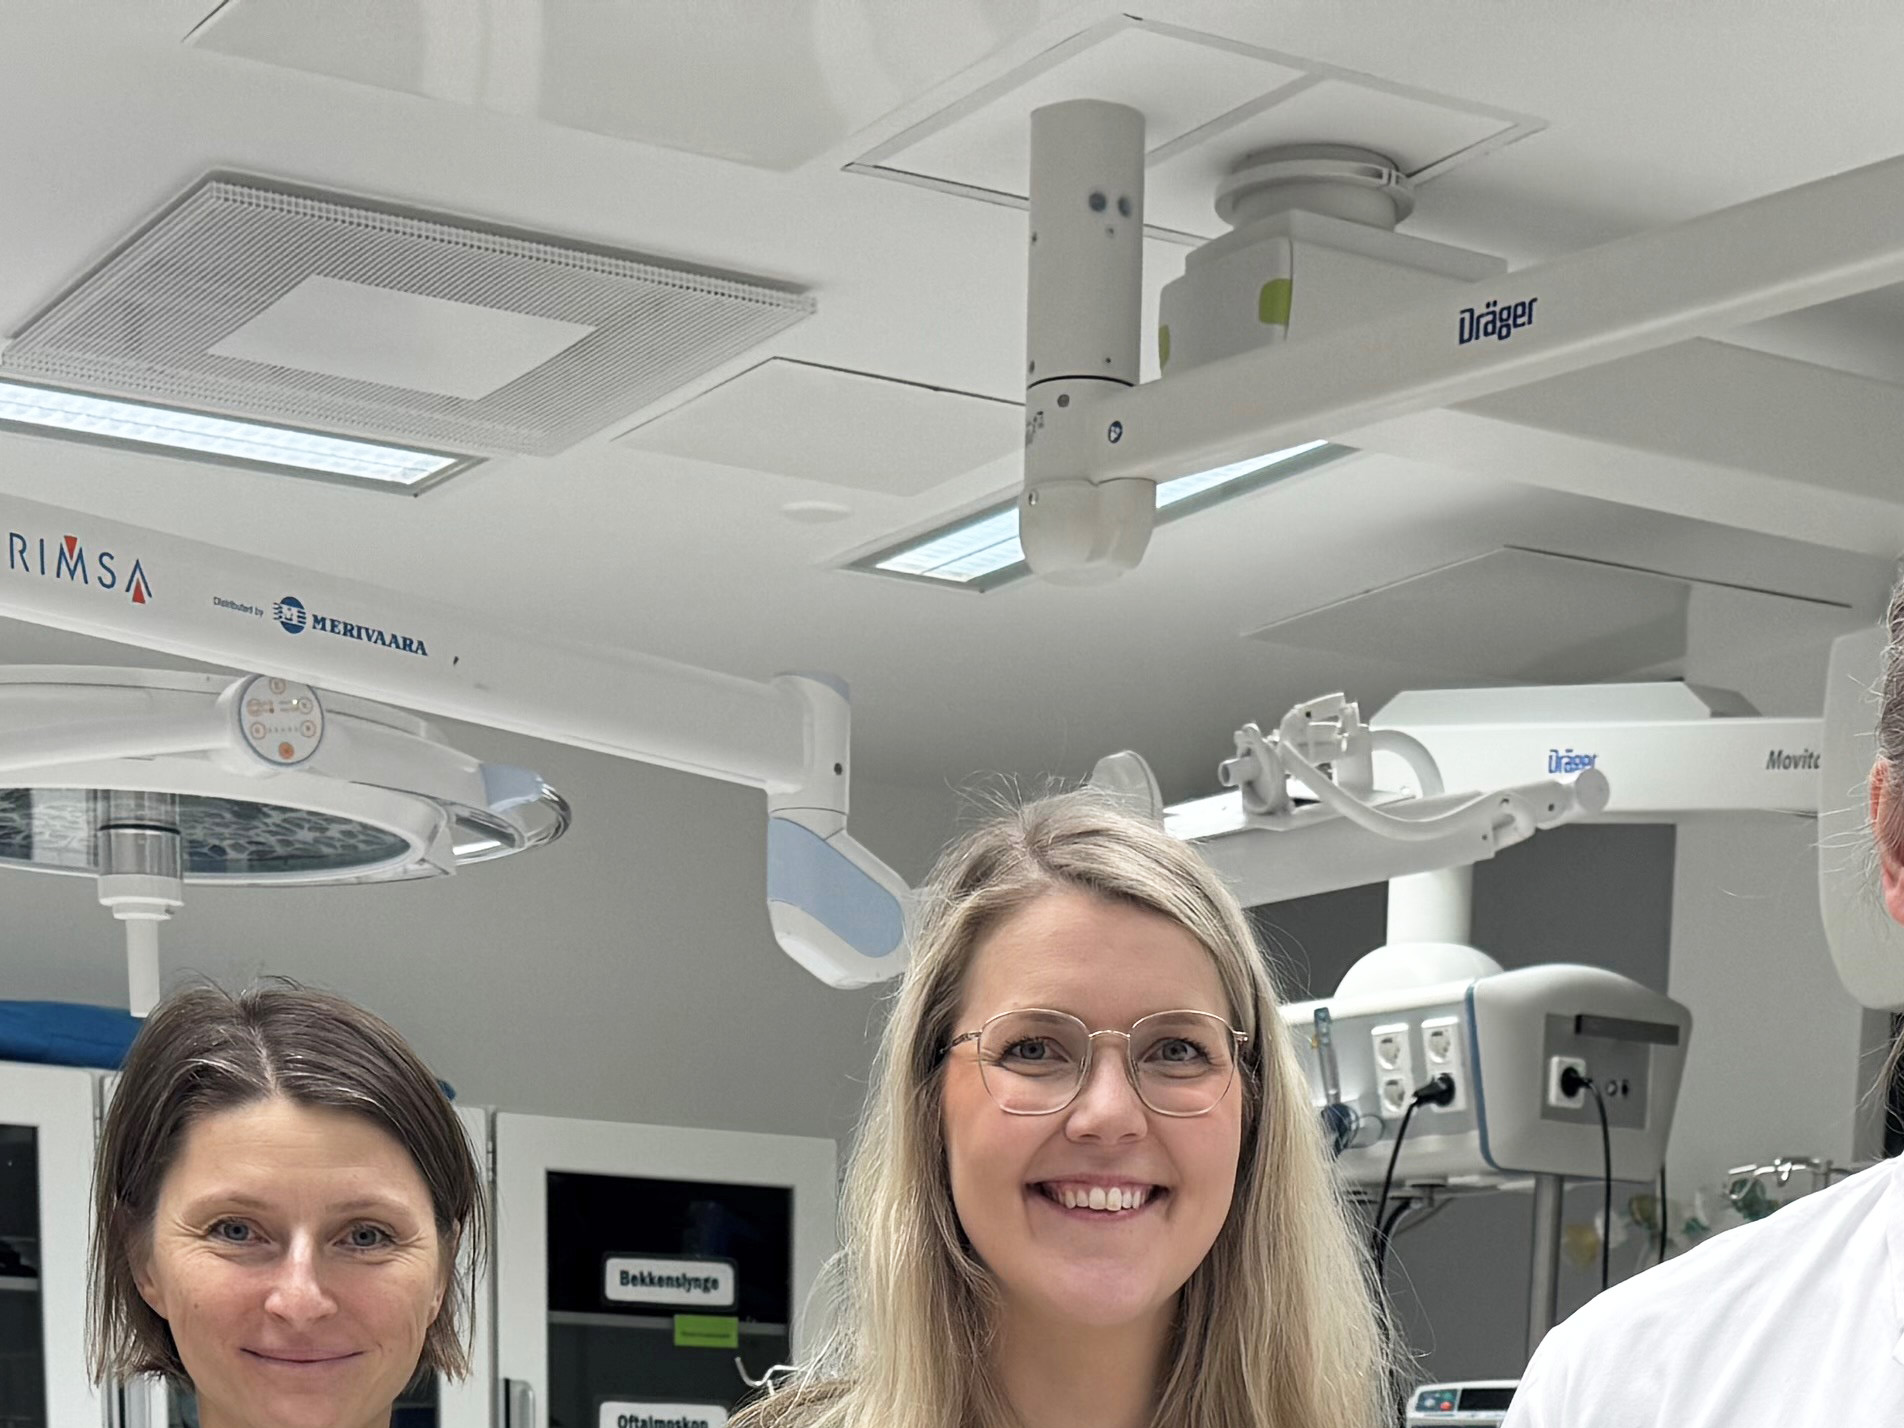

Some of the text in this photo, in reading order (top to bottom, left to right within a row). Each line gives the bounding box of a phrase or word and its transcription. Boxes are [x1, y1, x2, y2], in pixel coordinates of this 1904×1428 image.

[1458, 297, 1538, 345] Dräger
[8, 532, 153, 605] RIMSA
[311, 613, 428, 656] MERIVAARA
[619, 1270, 719, 1294] Bekkenslynge
